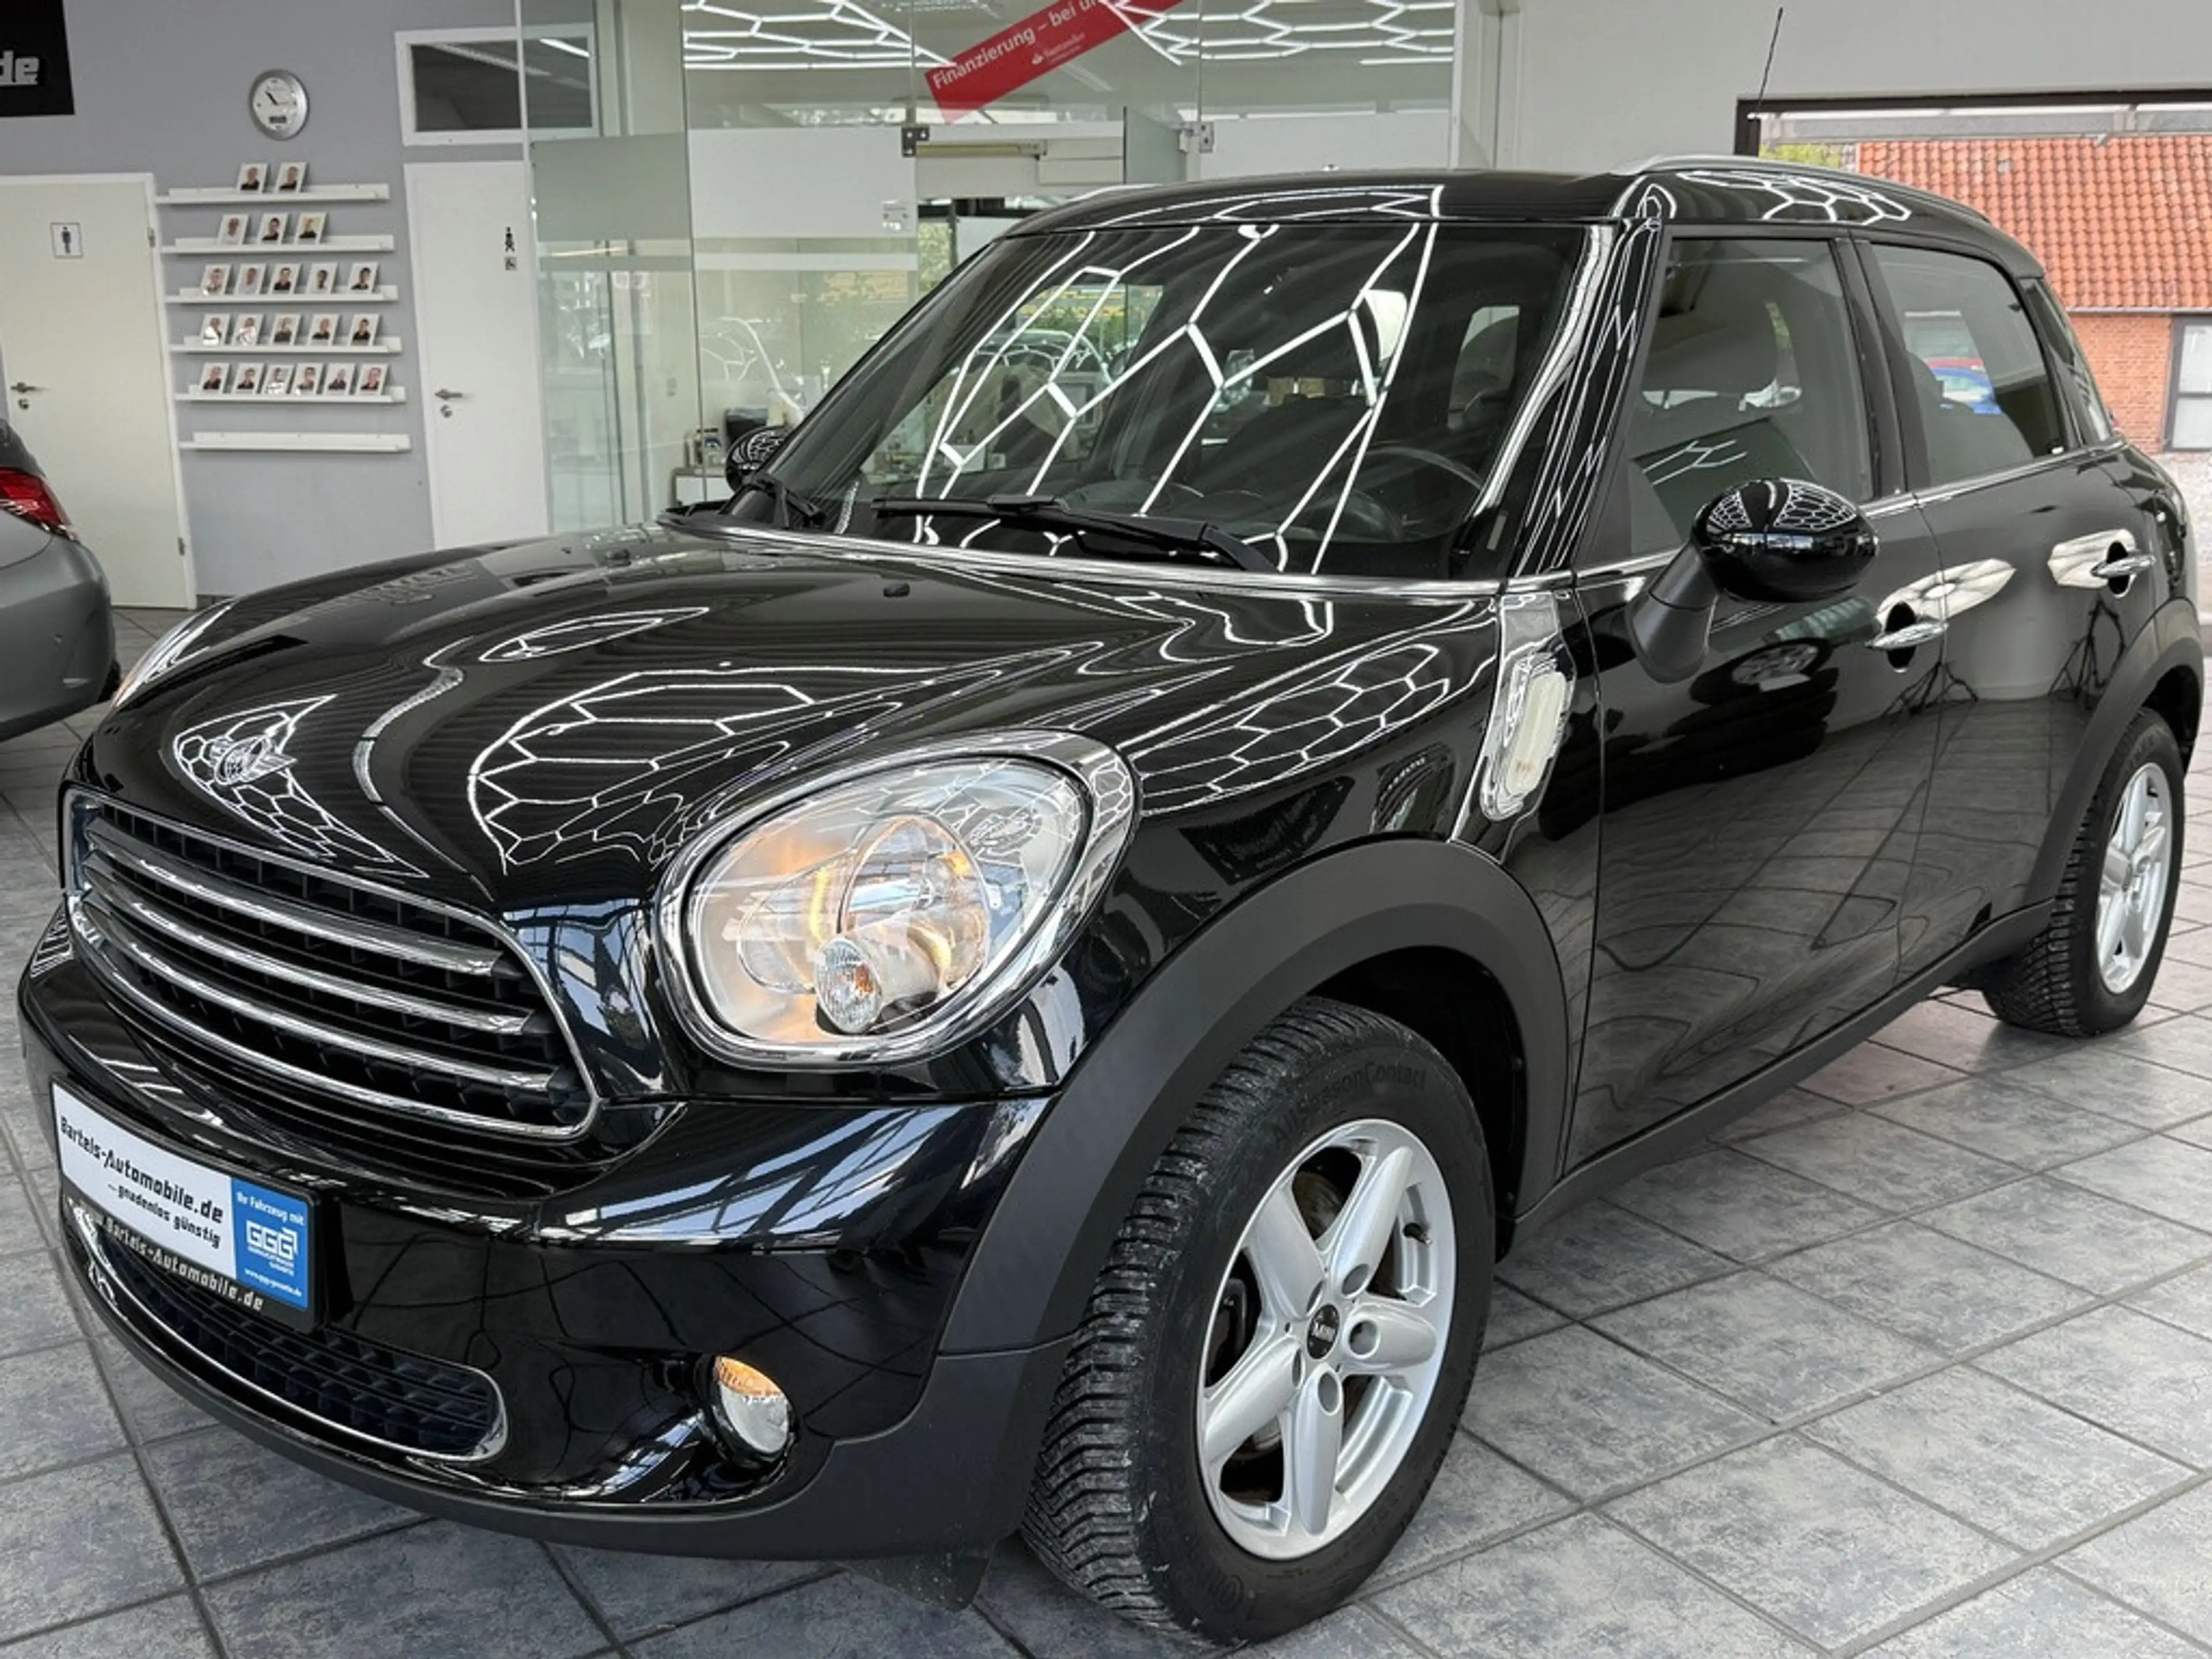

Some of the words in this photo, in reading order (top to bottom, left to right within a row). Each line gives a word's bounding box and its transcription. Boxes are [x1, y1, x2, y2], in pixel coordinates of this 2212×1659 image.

[932, 26, 1036, 89] Finanzierung
[1048, 2, 1077, 27] bei
[60, 1115, 224, 1224] Bartels-Automobile.de
[118, 1184, 170, 1222] gnadenlos
[173, 1215, 221, 1249] günstig
